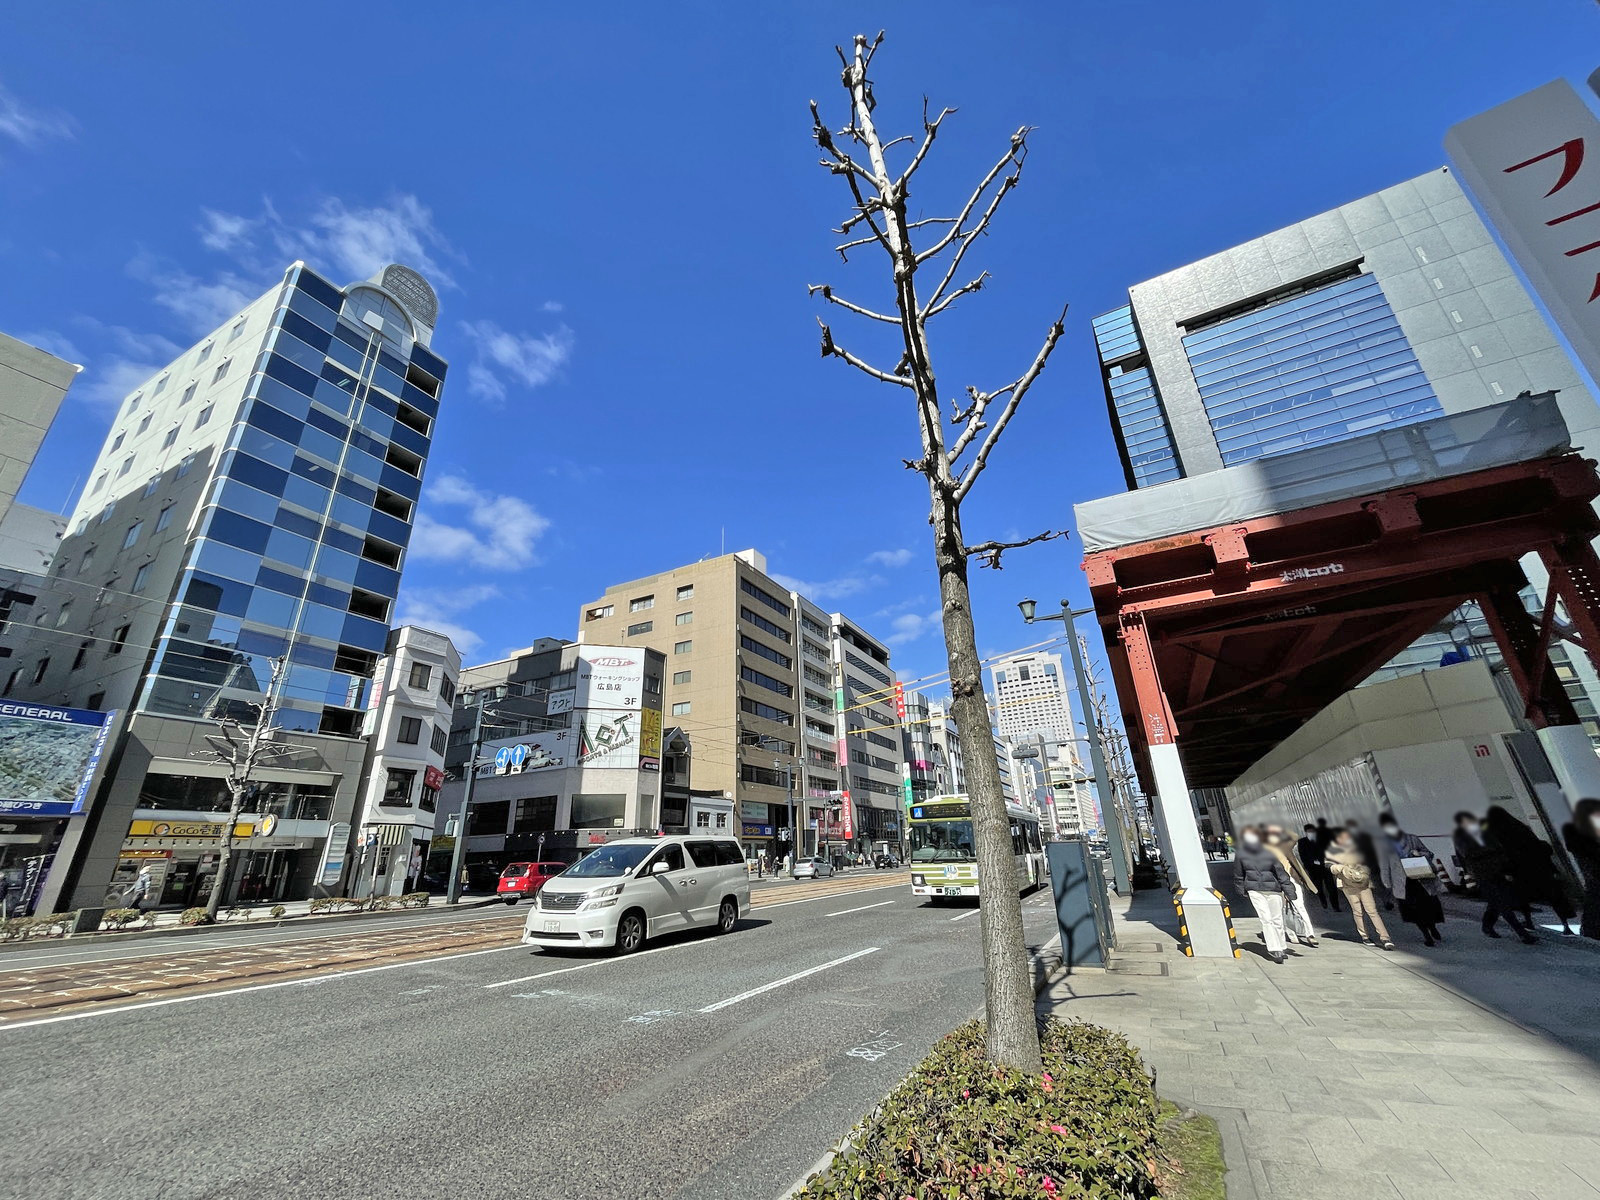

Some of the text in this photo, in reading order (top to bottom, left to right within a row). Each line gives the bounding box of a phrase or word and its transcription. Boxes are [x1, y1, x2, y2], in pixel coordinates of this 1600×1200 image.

[595, 658, 626, 666] MBT
[597, 683, 622, 691] 広島店
[624, 697, 638, 706] 3F
[0, 703, 72, 721] ENERAL
[556, 732, 567, 741] 3F
